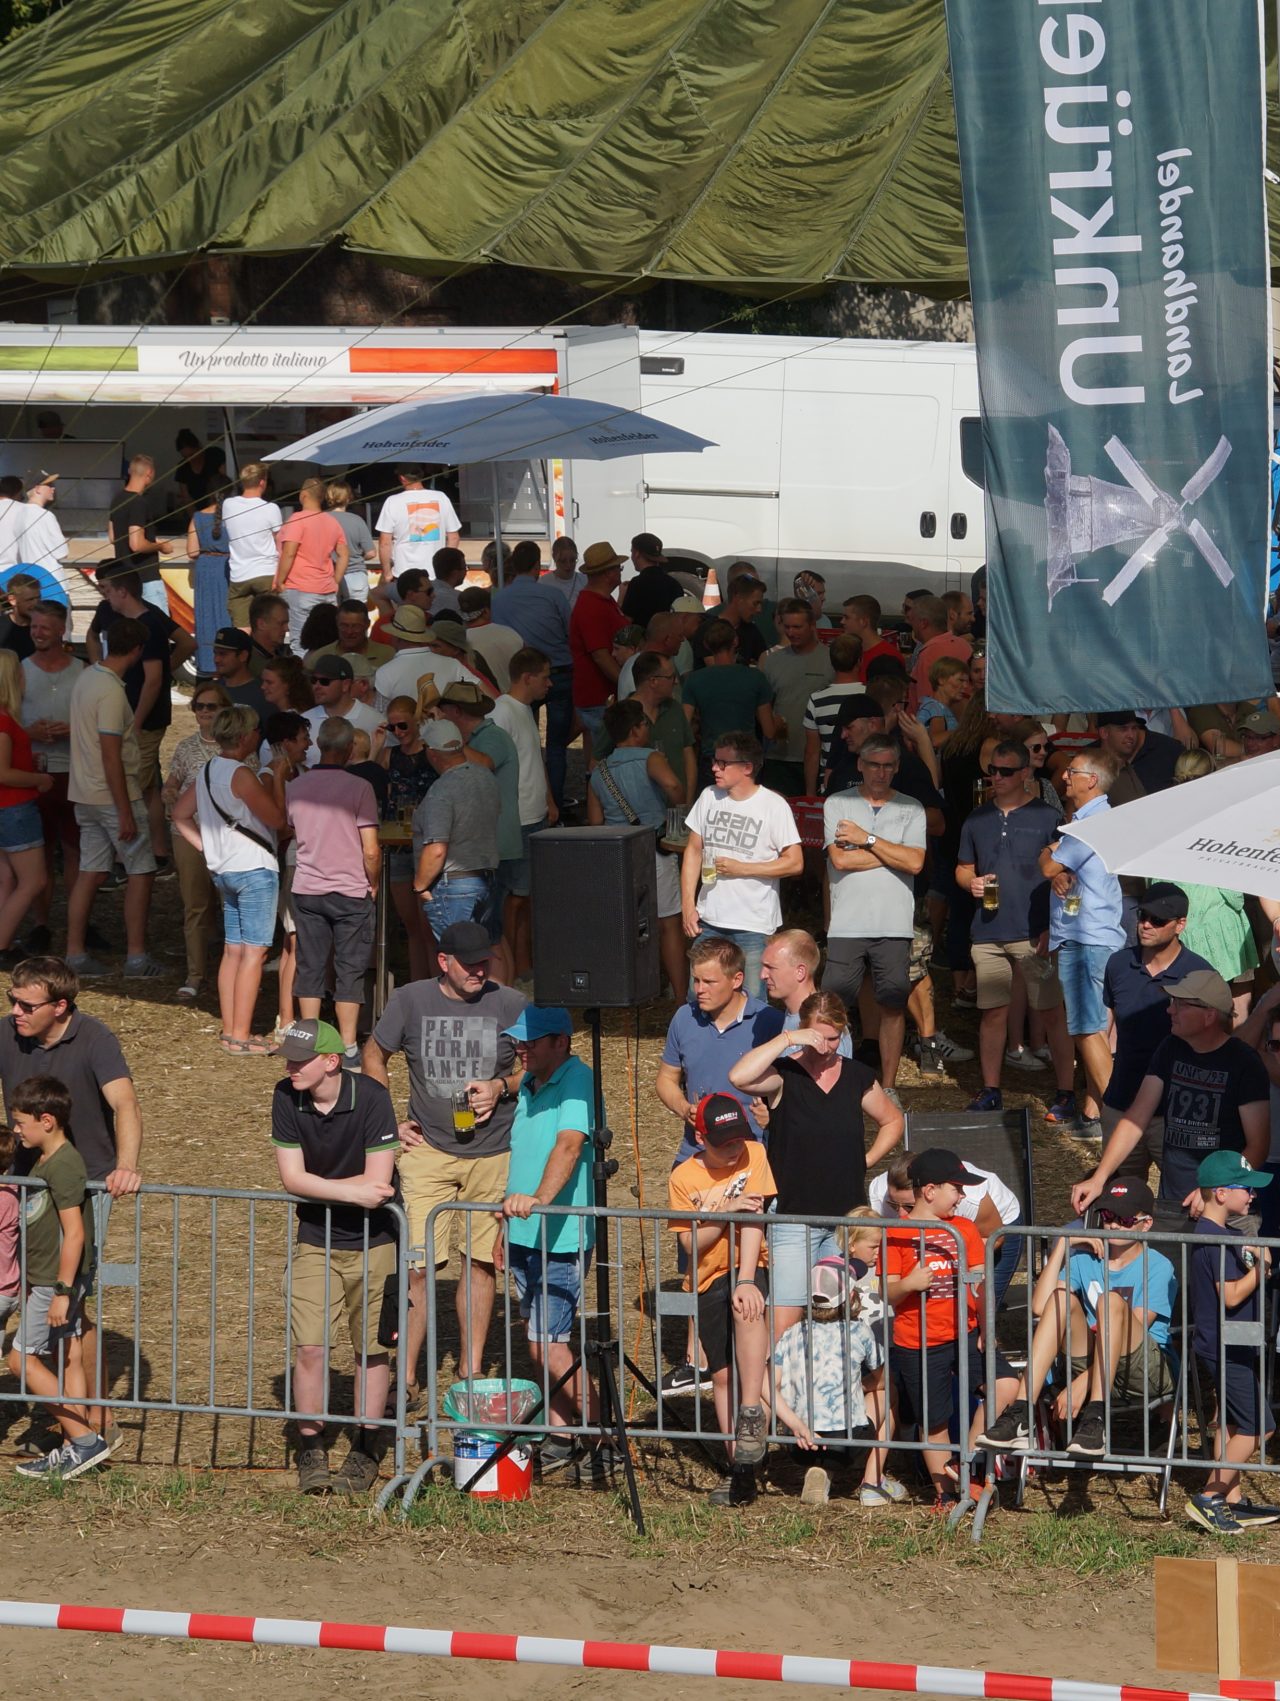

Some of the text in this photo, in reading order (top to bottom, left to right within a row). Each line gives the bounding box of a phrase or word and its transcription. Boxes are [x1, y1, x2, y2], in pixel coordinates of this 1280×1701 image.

[1038, 0, 1146, 406] Unkrüe
[1157, 148, 1204, 405] Landhandel
[207, 351, 269, 371] prodotto
[272, 351, 327, 368] italiano
[425, 1020, 464, 1038] PER
[424, 1040, 480, 1057] FORM
[427, 1060, 480, 1078] ANCE
